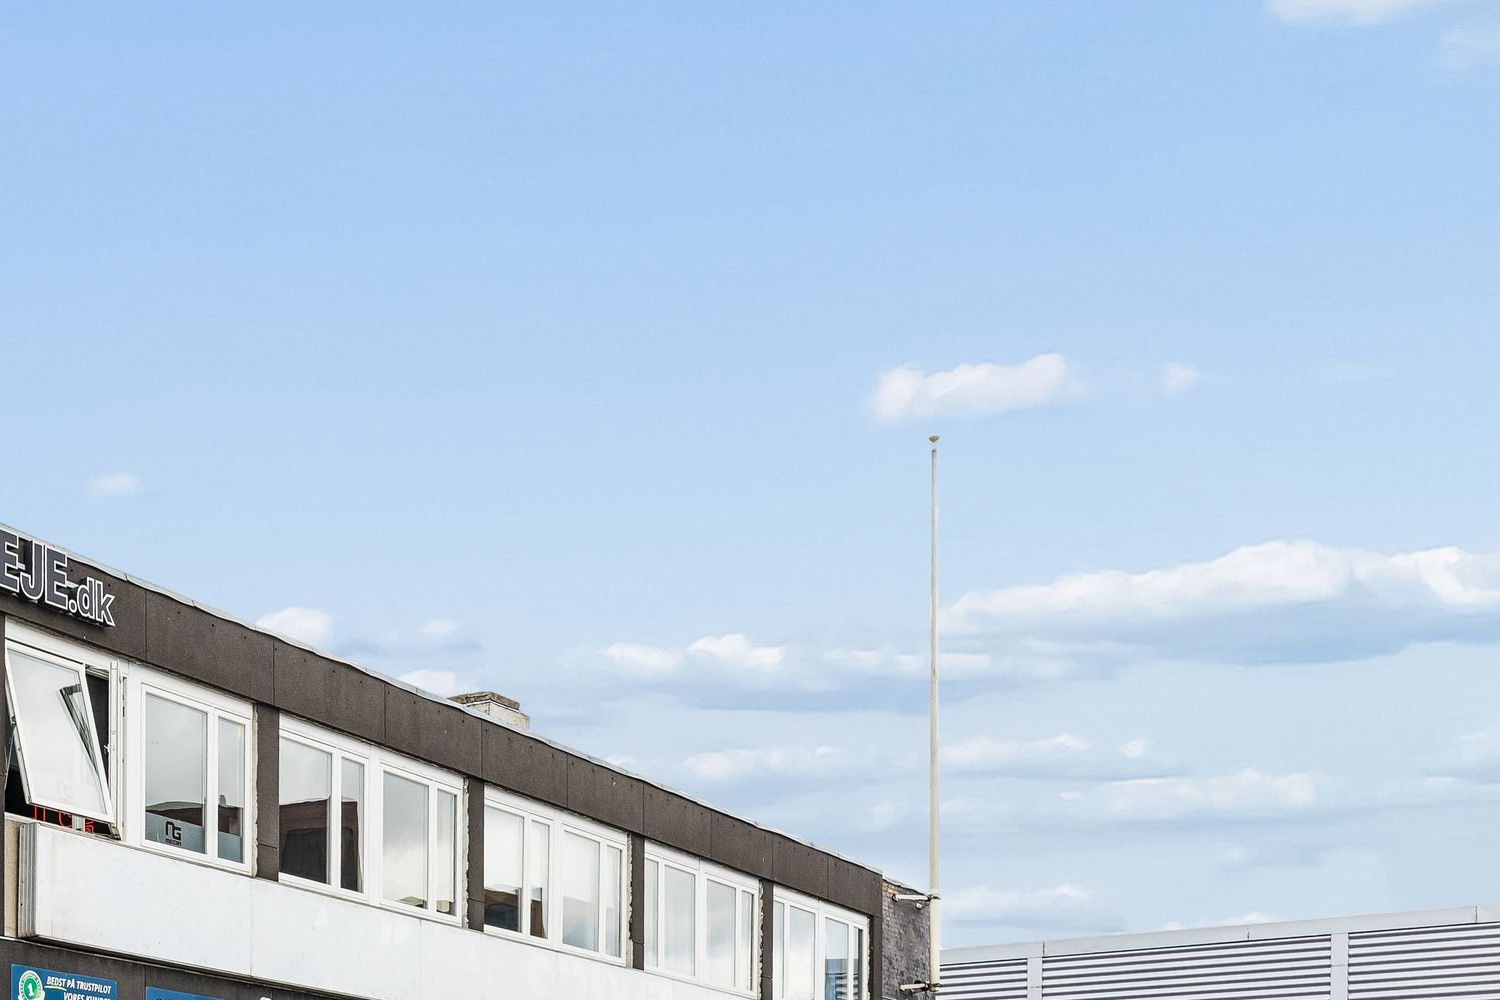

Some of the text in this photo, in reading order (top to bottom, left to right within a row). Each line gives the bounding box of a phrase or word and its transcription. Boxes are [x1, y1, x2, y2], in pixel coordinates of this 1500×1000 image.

[46, 976, 111, 994] BEDST PÅ TRUSTPILOT
